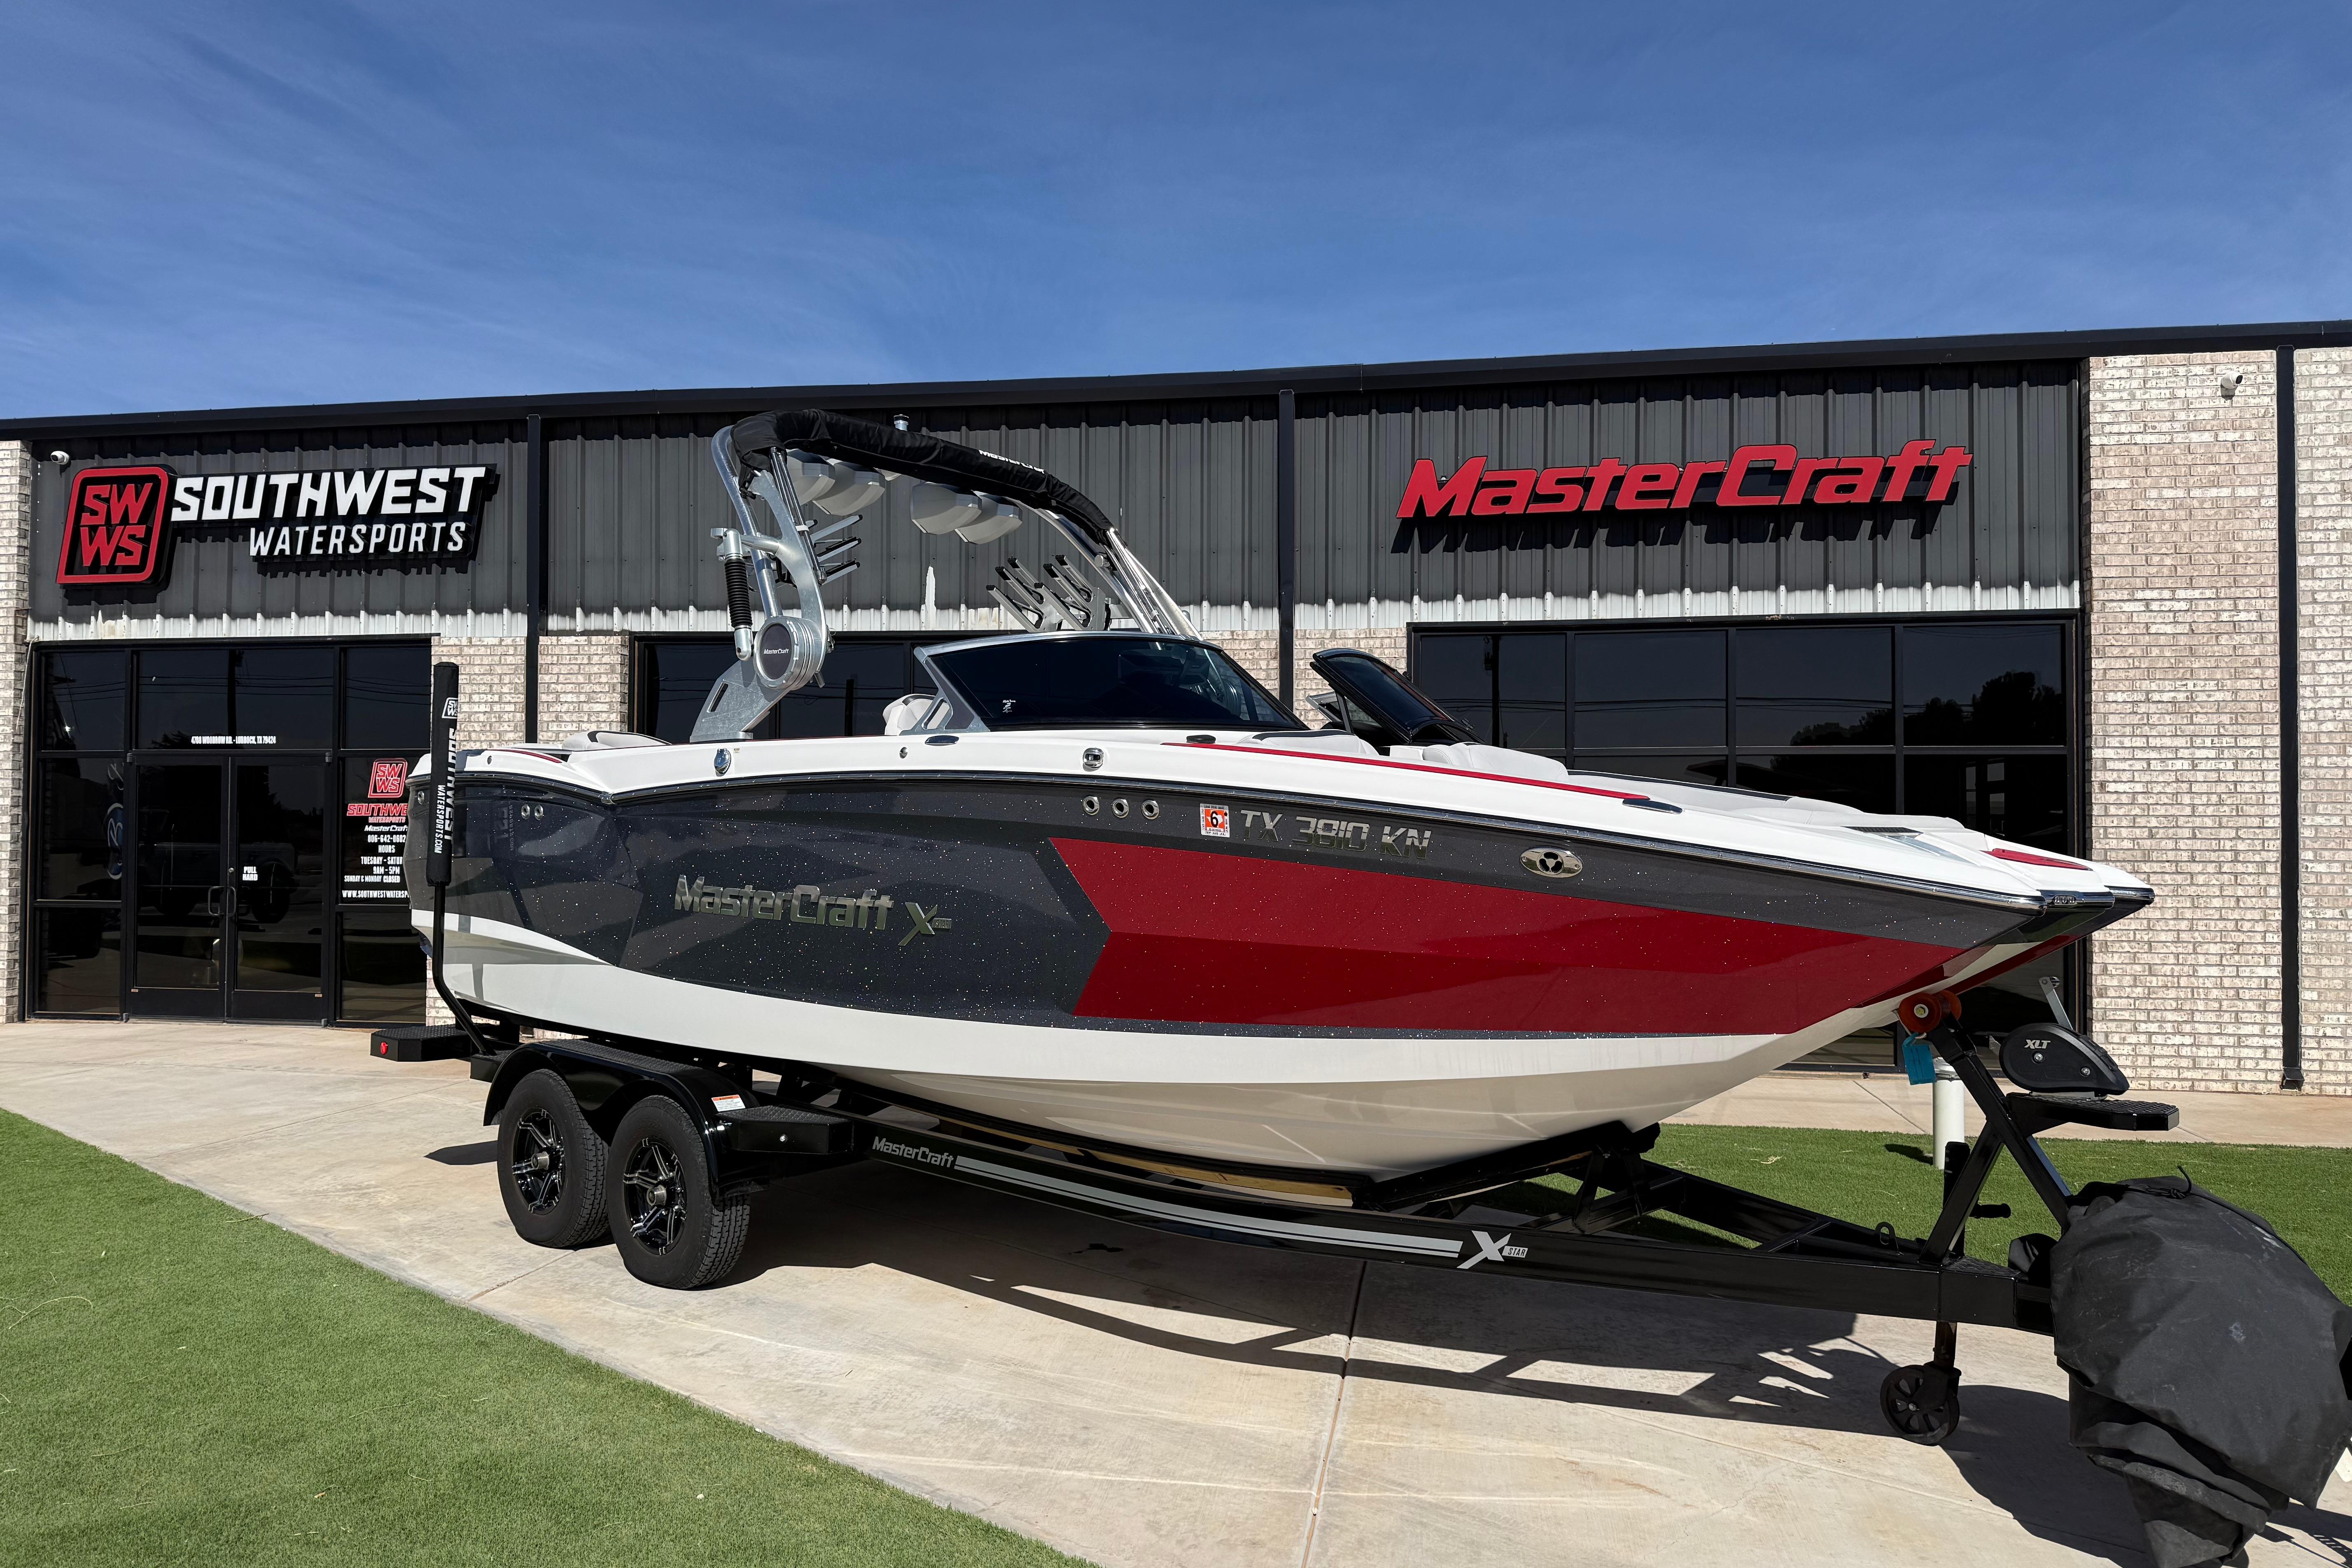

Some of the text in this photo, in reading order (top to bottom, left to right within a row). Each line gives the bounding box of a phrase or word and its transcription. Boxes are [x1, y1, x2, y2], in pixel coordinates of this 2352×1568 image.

[171, 466, 486, 521] SOUTHWEST
[1395, 439, 1973, 519] MasterCraft
[82, 482, 153, 525] SW
[81, 525, 145, 566] WS
[248, 522, 467, 557] WATERSPORTS
[376, 763, 402, 778] SW
[376, 778, 401, 793] WS
[347, 803, 408, 816] SOUTHWE
[434, 785, 446, 854] WATERSPORTS.COM
[1210, 811, 1219, 828] 6
[378, 845, 395, 853] HOURS
[1241, 810, 1283, 841] TX
[1292, 816, 1370, 852] 3810
[1379, 825, 1432, 859] KN
[361, 856, 383, 865] TUESDAY
[387, 856, 403, 865] SATUR
[373, 866, 384, 875] 9AM
[389, 866, 400, 875] 5PM
[674, 875, 894, 930] MasterCraft
[898, 902, 938, 946] X
[2024, 1039, 2051, 1049] XLT
[872, 1136, 954, 1168] MasterCraft
[1456, 1230, 1526, 1269] X STAR
